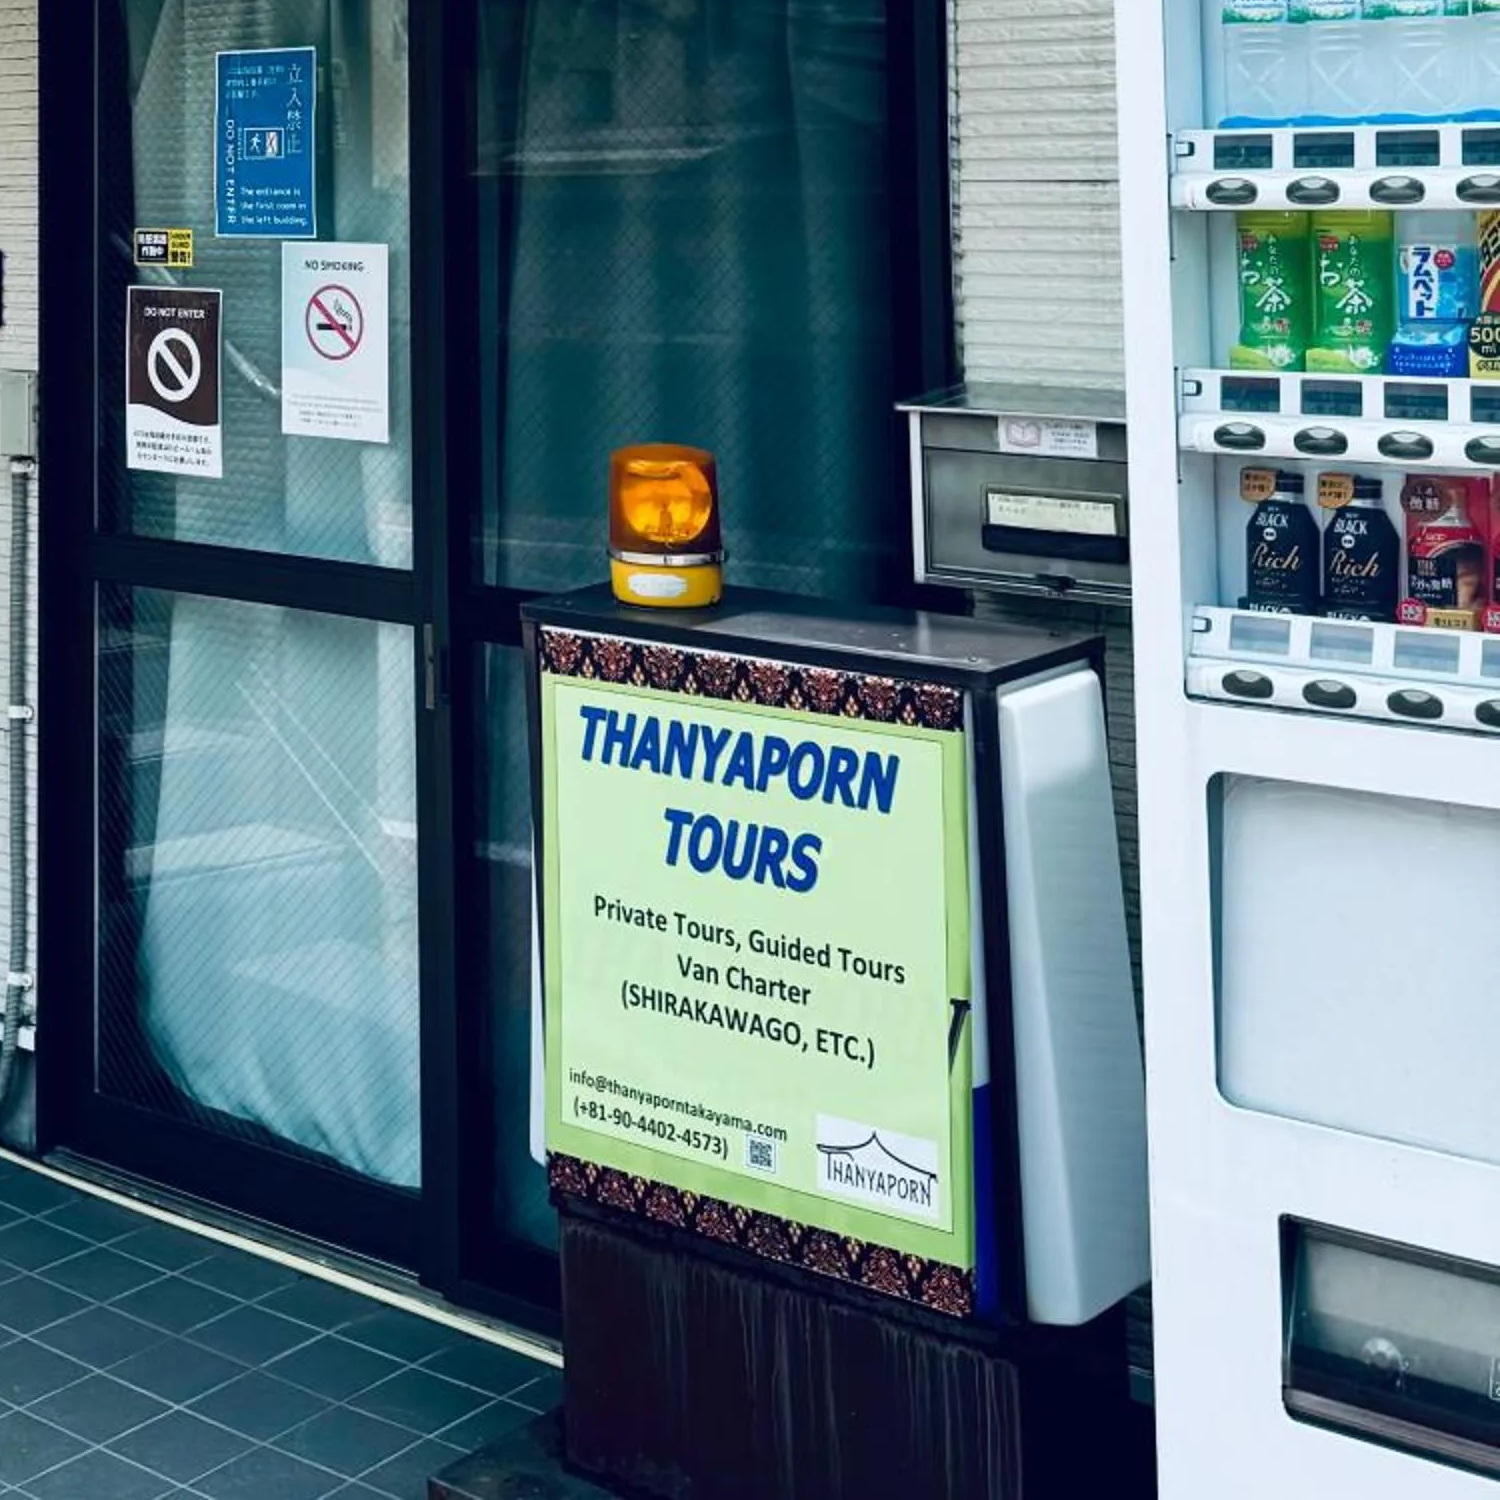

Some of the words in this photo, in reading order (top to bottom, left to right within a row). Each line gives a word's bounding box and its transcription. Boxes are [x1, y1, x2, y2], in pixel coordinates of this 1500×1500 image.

[286, 63, 303, 153] 立入禁止
[304, 260, 318, 271] NO
[320, 260, 365, 273] SMOKING
[144, 307, 156, 317] DO
[158, 307, 176, 318] NOT
[178, 308, 205, 320] ENTER
[1256, 512, 1288, 527] BLACK
[1334, 517, 1368, 535] BLACK
[1252, 542, 1300, 570] Rich
[1330, 550, 1379, 577] Rich
[580, 705, 900, 814] THANYAPORN
[664, 807, 823, 892] TOURS
[595, 896, 668, 932] Private
[674, 912, 742, 952] Tours,
[749, 929, 831, 968] Guided
[838, 947, 906, 984] Tours
[677, 953, 719, 985] Van
[726, 966, 812, 1005] Charter
[622, 980, 809, 1053] (SHIRAKAWAGO,
[816, 1028, 876, 1069] ETC.)
[569, 1067, 788, 1142] info@thanyaporntakayama.com
[574, 1096, 729, 1161] (+81-90-4402-4573)
[818, 1150, 937, 1207] THANYAPORN
